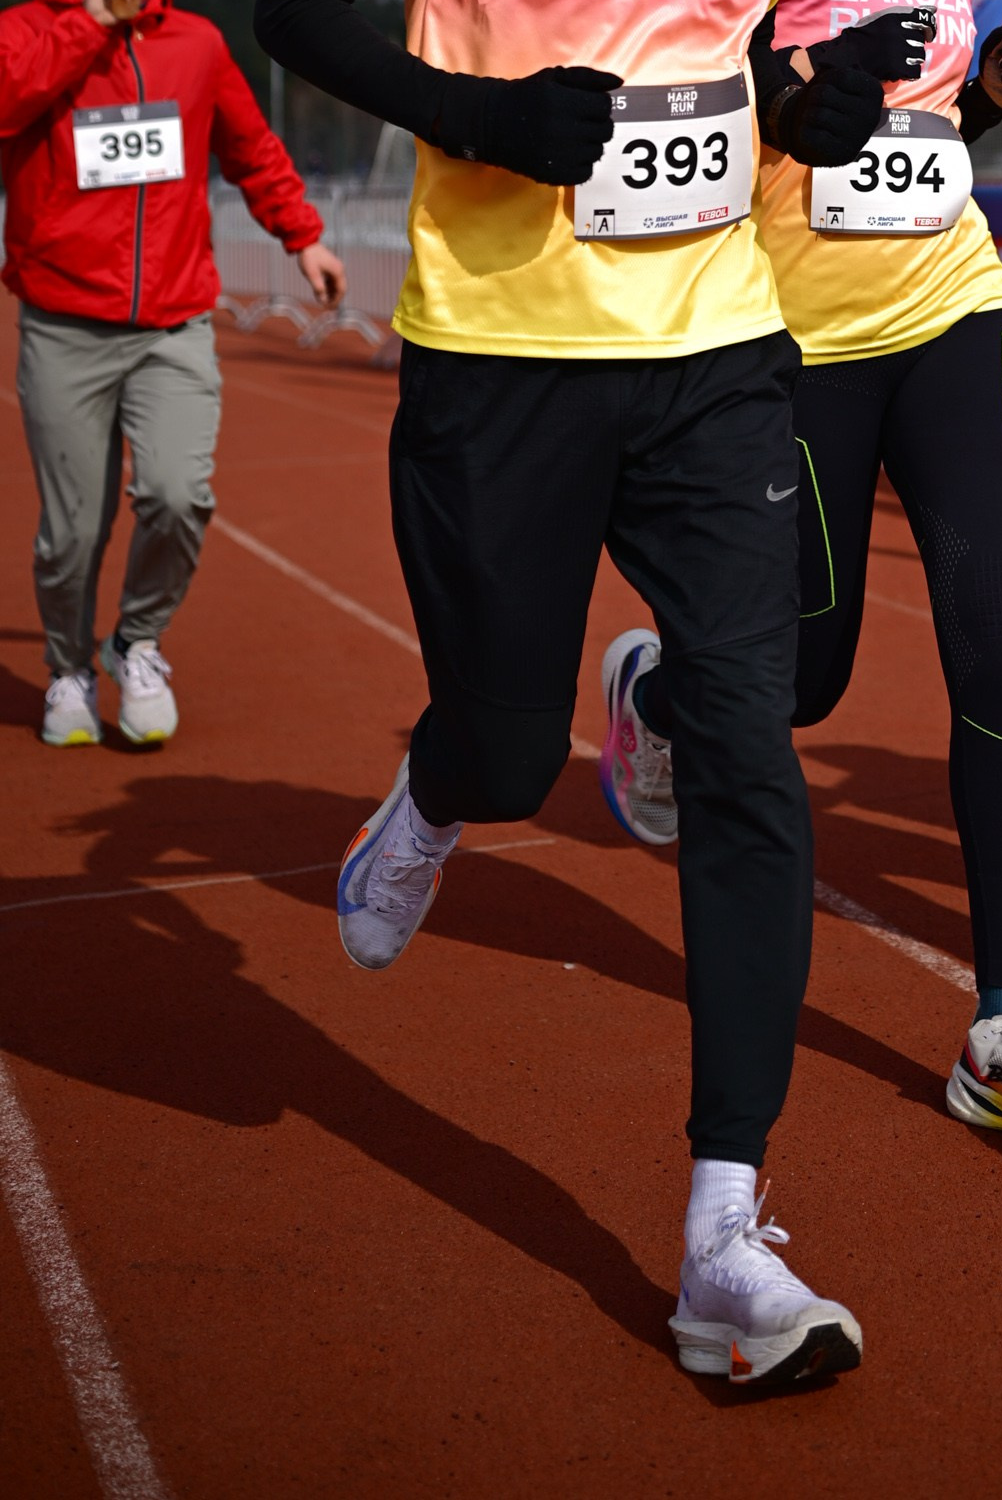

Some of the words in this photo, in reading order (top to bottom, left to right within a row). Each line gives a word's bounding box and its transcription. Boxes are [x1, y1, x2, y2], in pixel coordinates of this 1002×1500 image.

[667, 91, 698, 103] HARD
[671, 102, 695, 113] RUN
[889, 114, 911, 124] HARD
[891, 123, 909, 131] RUN
[100, 128, 164, 162] 395
[621, 131, 729, 190] 393
[850, 150, 945, 193] 394
[655, 213, 688, 222] ВЫСШАЯ
[699, 207, 728, 221] TEBOIL
[830, 214, 839, 224] A
[598, 217, 609, 233] A
[915, 218, 941, 226] TEBOIL
